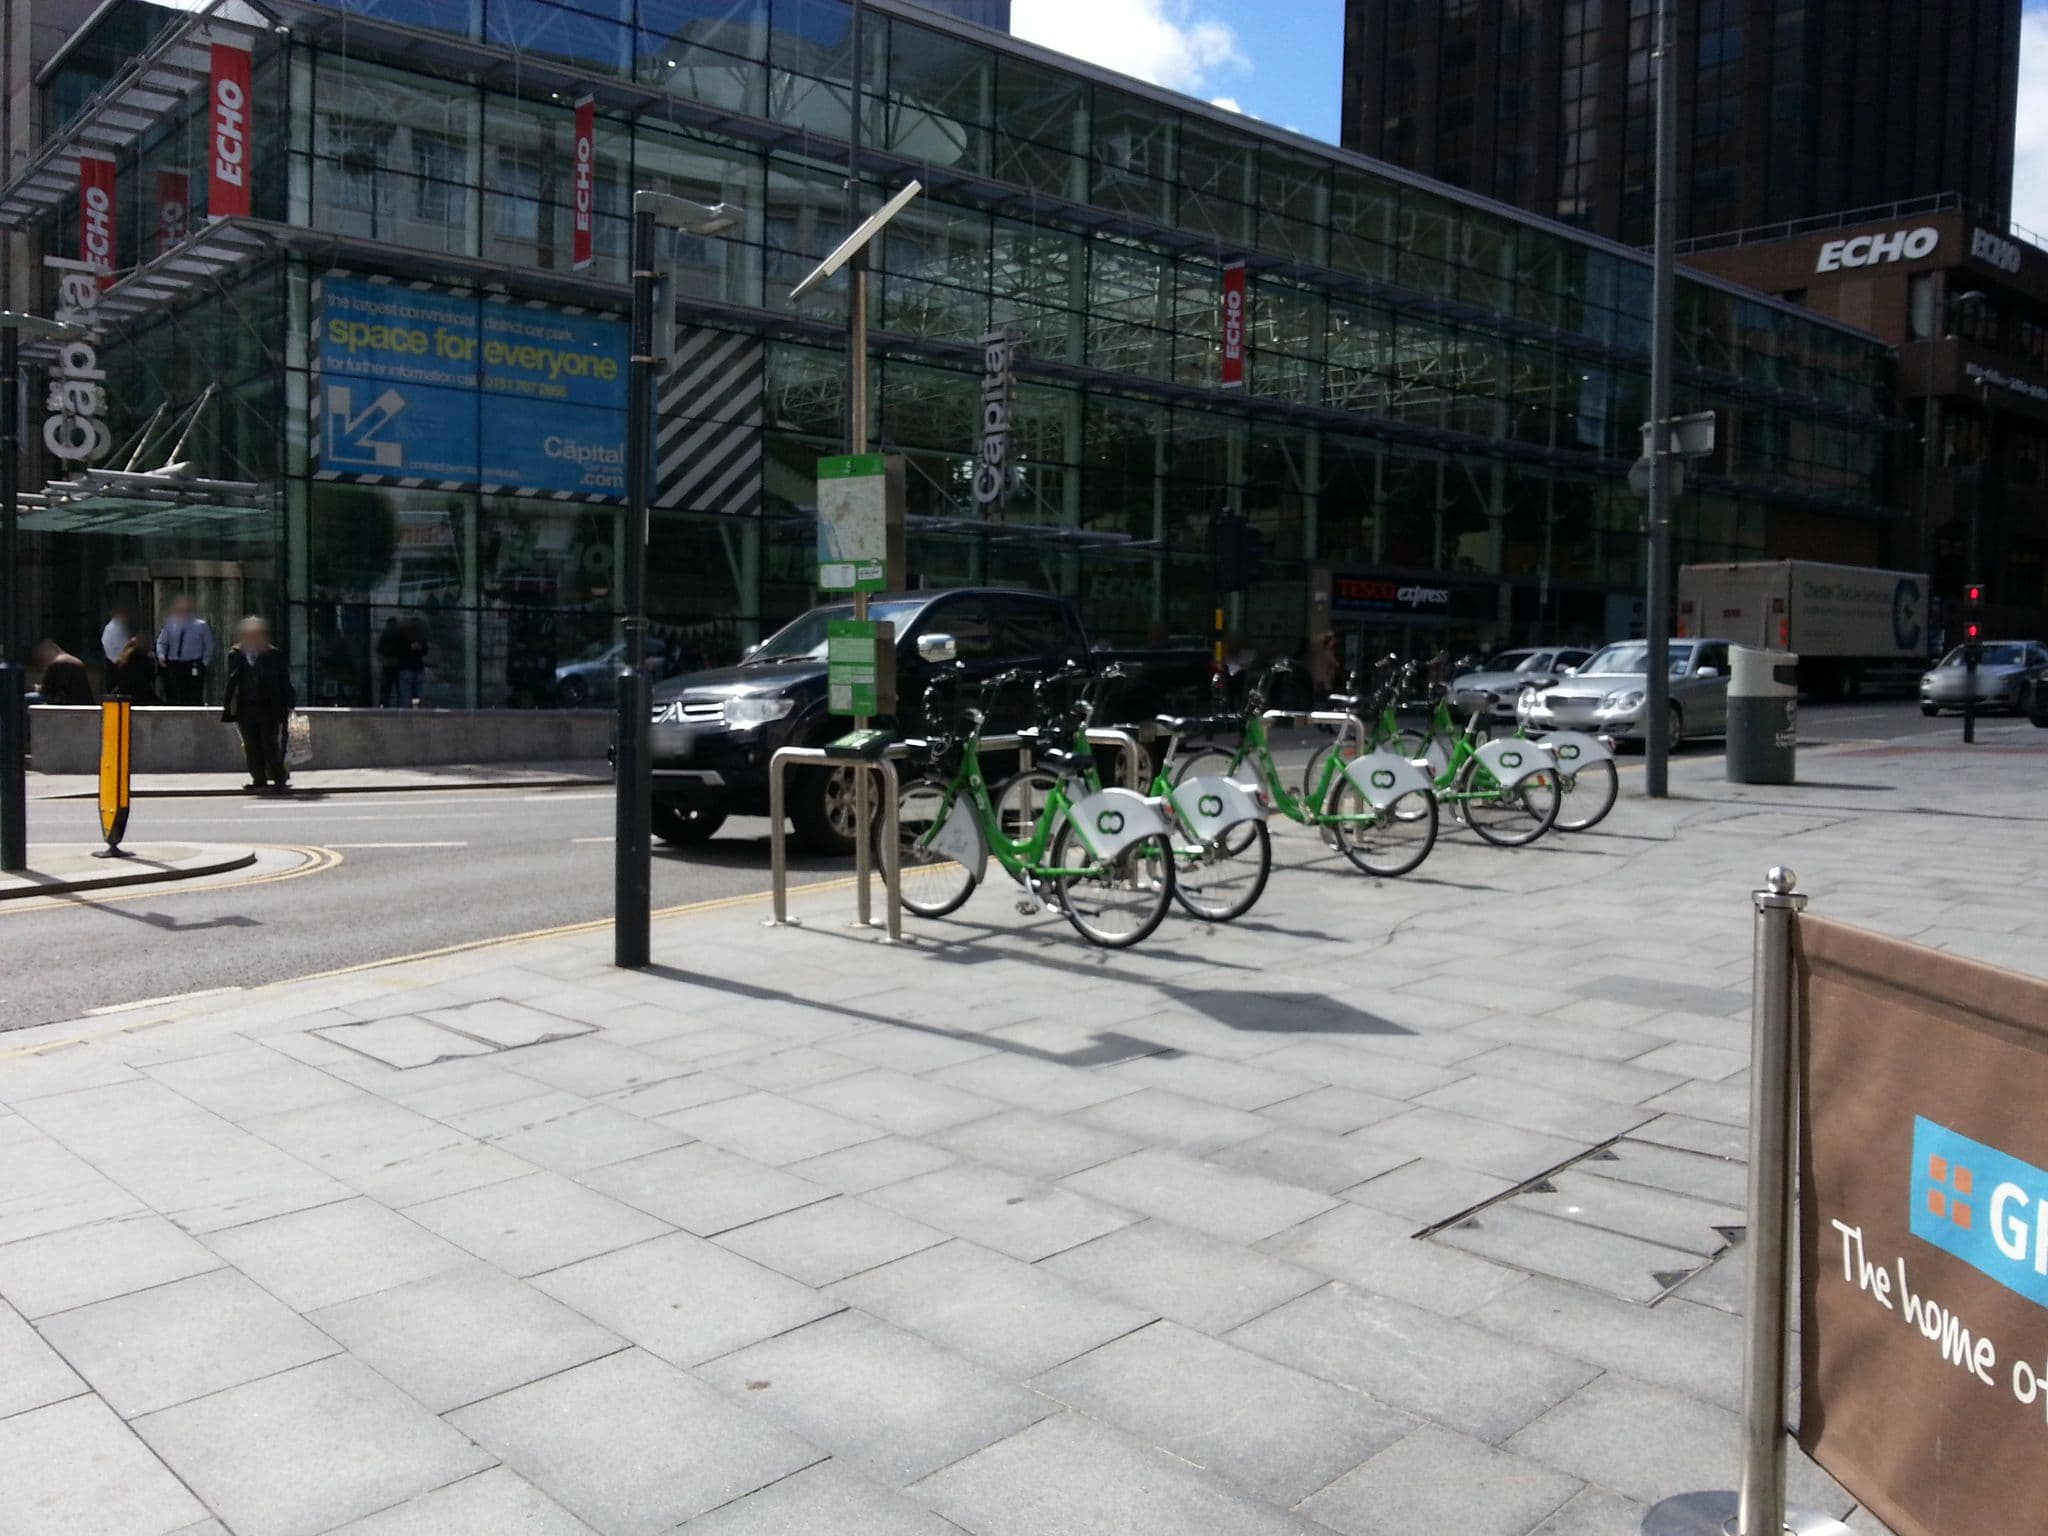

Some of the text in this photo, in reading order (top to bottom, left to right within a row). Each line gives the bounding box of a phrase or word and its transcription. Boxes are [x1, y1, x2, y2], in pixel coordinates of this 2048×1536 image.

[217, 78, 245, 187] ECHO
[577, 137, 590, 231] ECHO
[86, 186, 109, 273] ECHO
[1816, 226, 1939, 274] ECHO
[1971, 226, 2022, 274] ECHO
[328, 293, 349, 308] the
[352, 296, 398, 316] largest
[399, 304, 476, 327] commercial
[1226, 290, 1241, 359] ECHO
[44, 255, 105, 461] Captal
[327, 354, 345, 370] for
[346, 356, 386, 375] further
[388, 363, 456, 383] information
[328, 319, 618, 382] space for everyone
[974, 331, 1010, 503] Capital
[580, 472, 624, 488] .com
[1339, 579, 1449, 608] TESCO express
[1831, 1218, 1893, 1310] The
[1897, 1256, 1996, 1387] home
